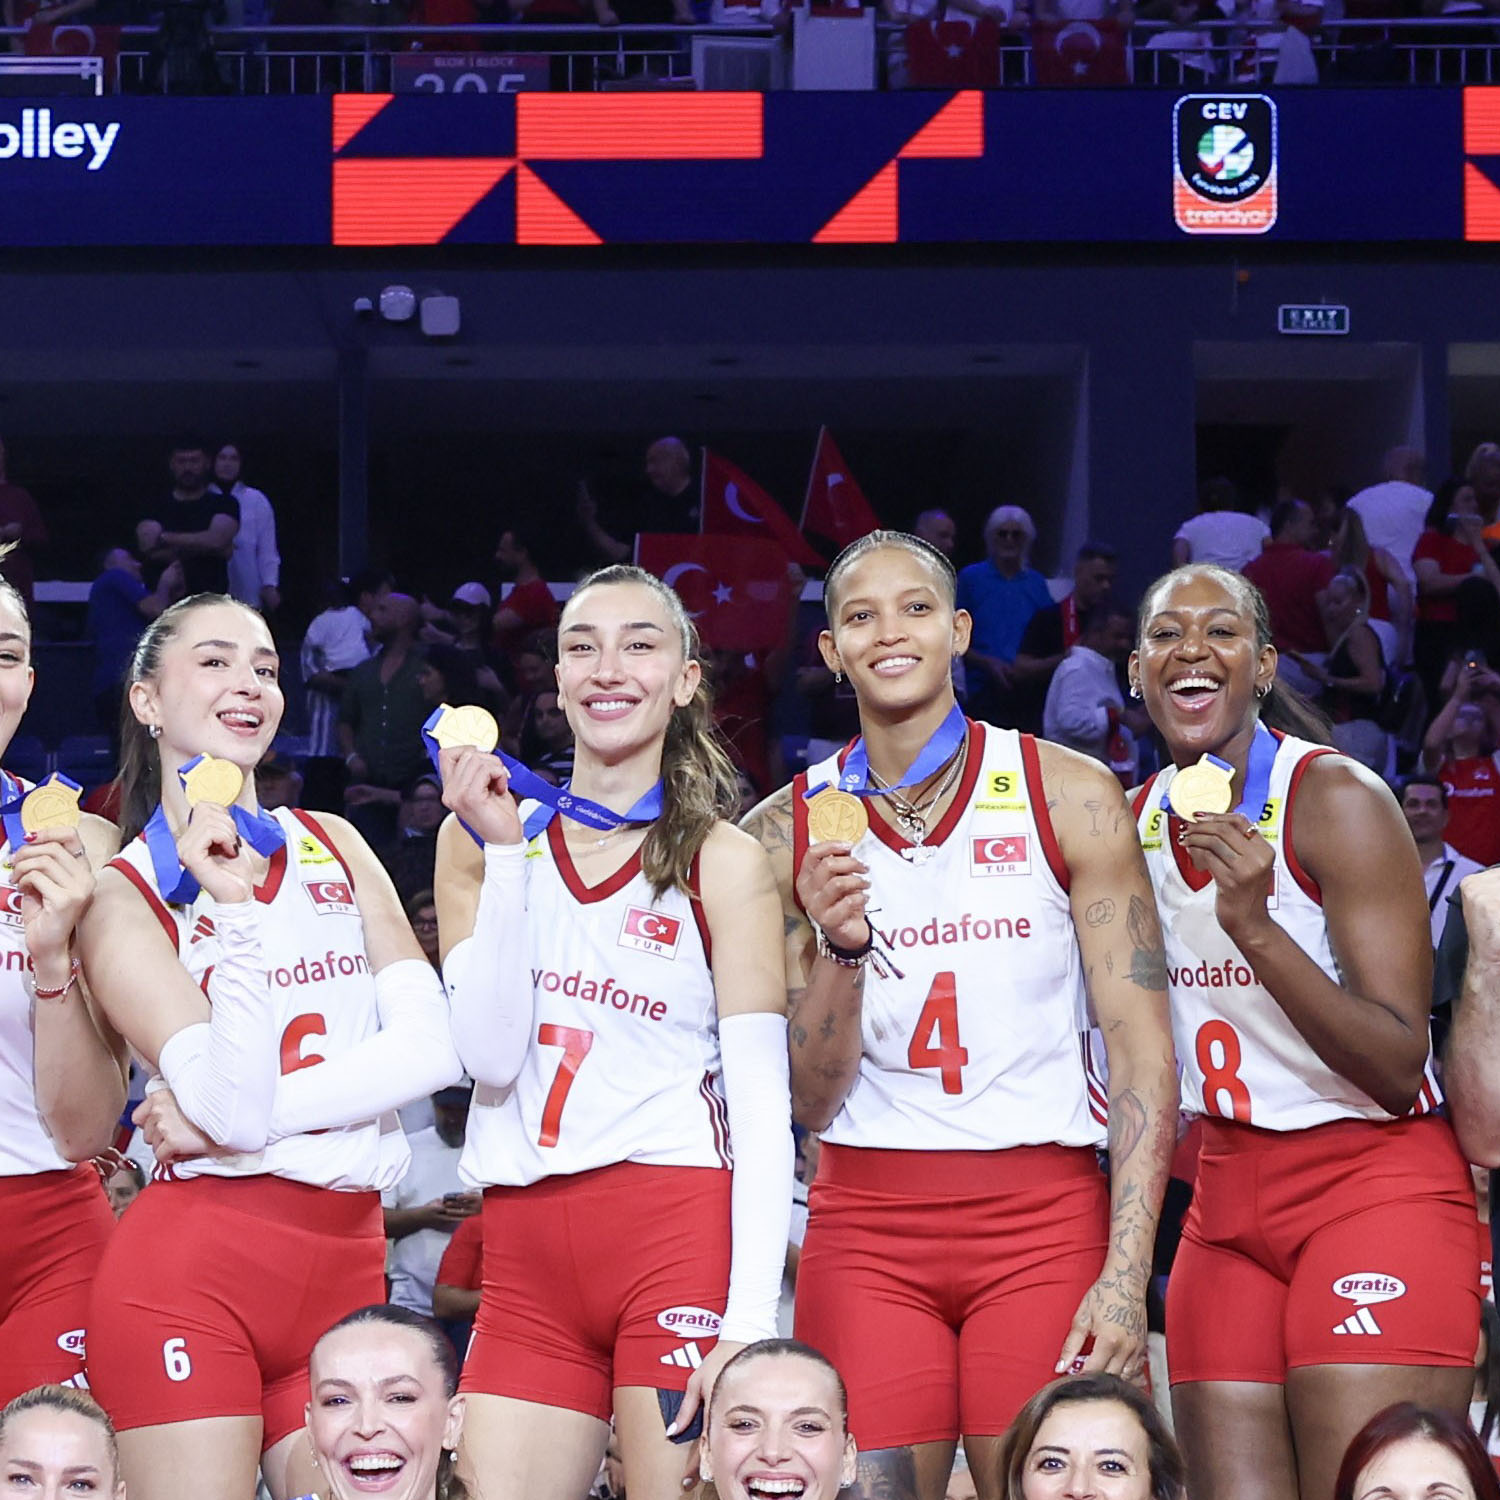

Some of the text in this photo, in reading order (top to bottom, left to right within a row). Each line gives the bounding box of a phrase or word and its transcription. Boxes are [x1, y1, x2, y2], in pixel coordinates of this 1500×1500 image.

[1202, 102, 1249, 120] CEV
[992, 775, 1011, 795] S
[983, 864, 1017, 875] TUR
[324, 900, 351, 914] TUR
[880, 910, 1032, 947] vodafone
[631, 940, 662, 956] TUR
[1166, 959, 1260, 989] vodafo
[530, 968, 668, 1023] vodafone
[907, 971, 968, 1095] 4
[1194, 1019, 1252, 1122] 8
[537, 1023, 595, 1148] 7
[1341, 1276, 1398, 1297] gratis
[665, 1307, 720, 1331] gratis
[163, 1338, 192, 1381] 6
